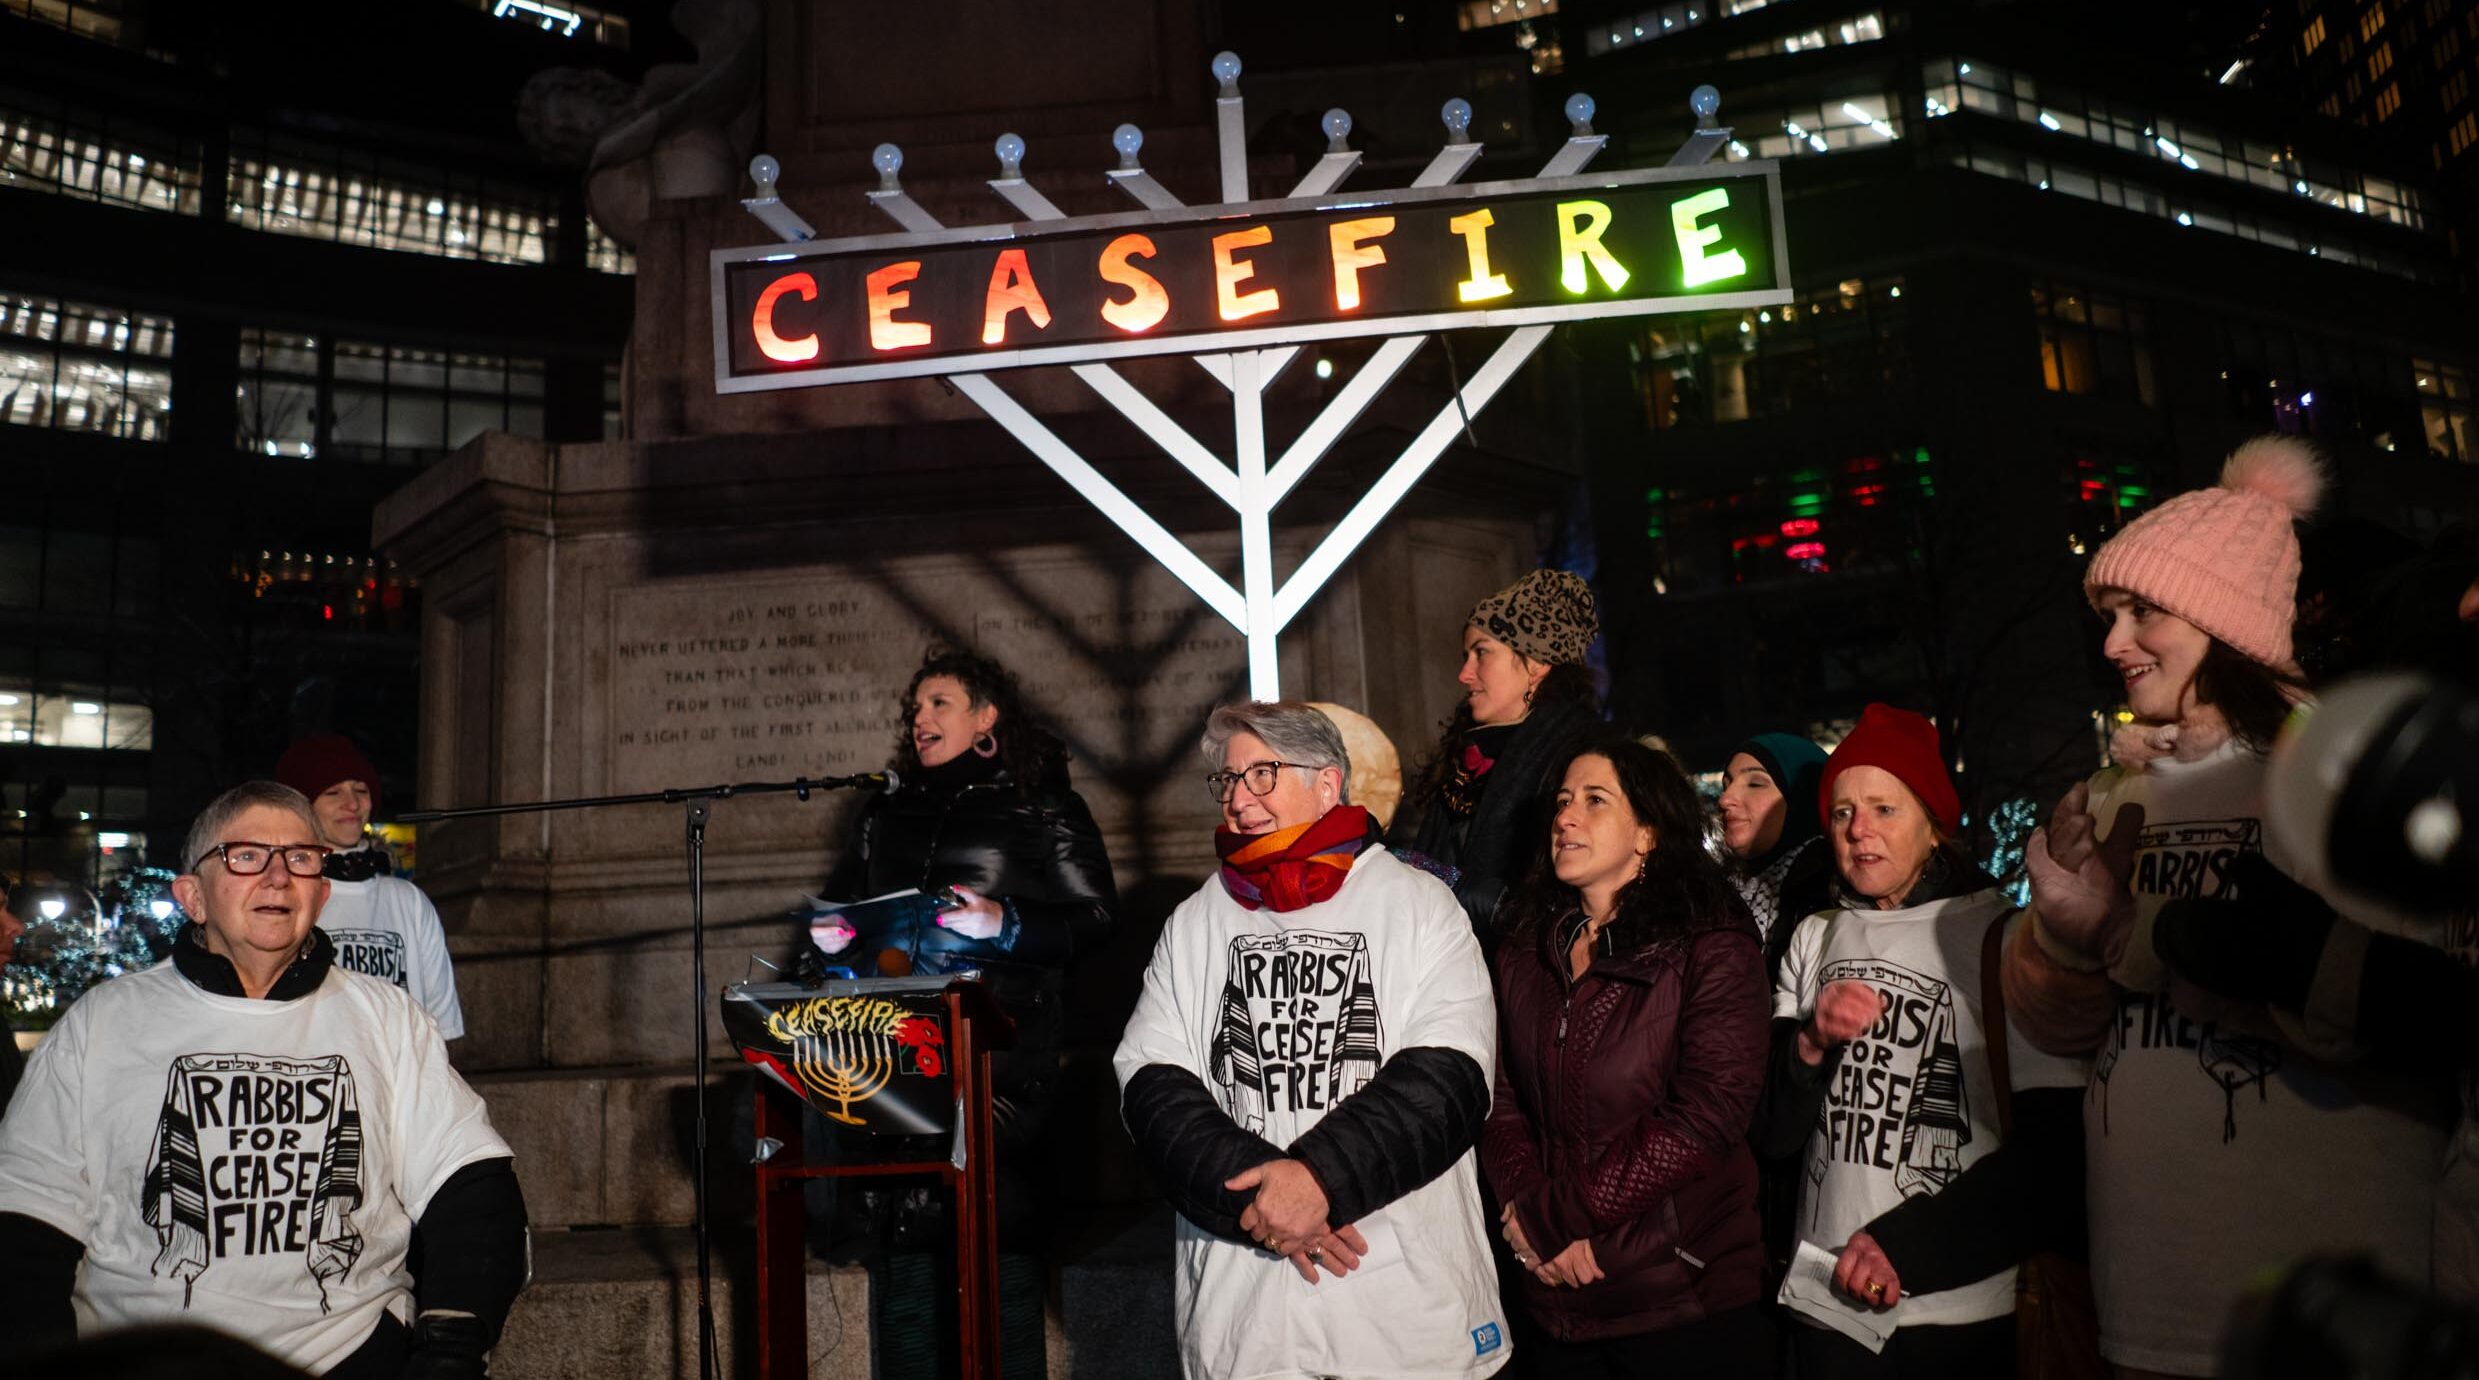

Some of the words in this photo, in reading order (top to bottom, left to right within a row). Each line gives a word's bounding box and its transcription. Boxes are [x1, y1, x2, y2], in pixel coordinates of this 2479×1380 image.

[752, 189, 1746, 363] CEASEFIRE
[767, 603, 797, 620] AND
[807, 600, 859, 618] GLORY
[618, 640, 670, 659] NEVER
[677, 637, 749, 655] UTTERED
[758, 636, 767, 650] A
[776, 632, 817, 648] MORE
[664, 669, 706, 685] THAN
[716, 666, 757, 684] THAT
[768, 663, 817, 677] WHICH
[666, 697, 711, 714] FROM
[721, 696, 752, 711] THE
[618, 731, 635, 746] IN
[644, 727, 689, 746] SIGHT
[699, 726, 719, 742] OF
[731, 723, 759, 741] THE
[768, 720, 814, 738] FIRST
[341, 944, 394, 978] ABBIS
[1243, 951, 1350, 999] RABBIS
[1837, 961, 1868, 978] שלום
[766, 997, 912, 1044] CEASEFIRE
[216, 1054, 260, 1070] שלום
[191, 1076, 332, 1129] RABBIS
[230, 1128, 302, 1151] FOR
[1829, 1110, 1900, 1171] FIRE
[210, 1152, 320, 1200] CEASE
[214, 1200, 309, 1258] FIRE
